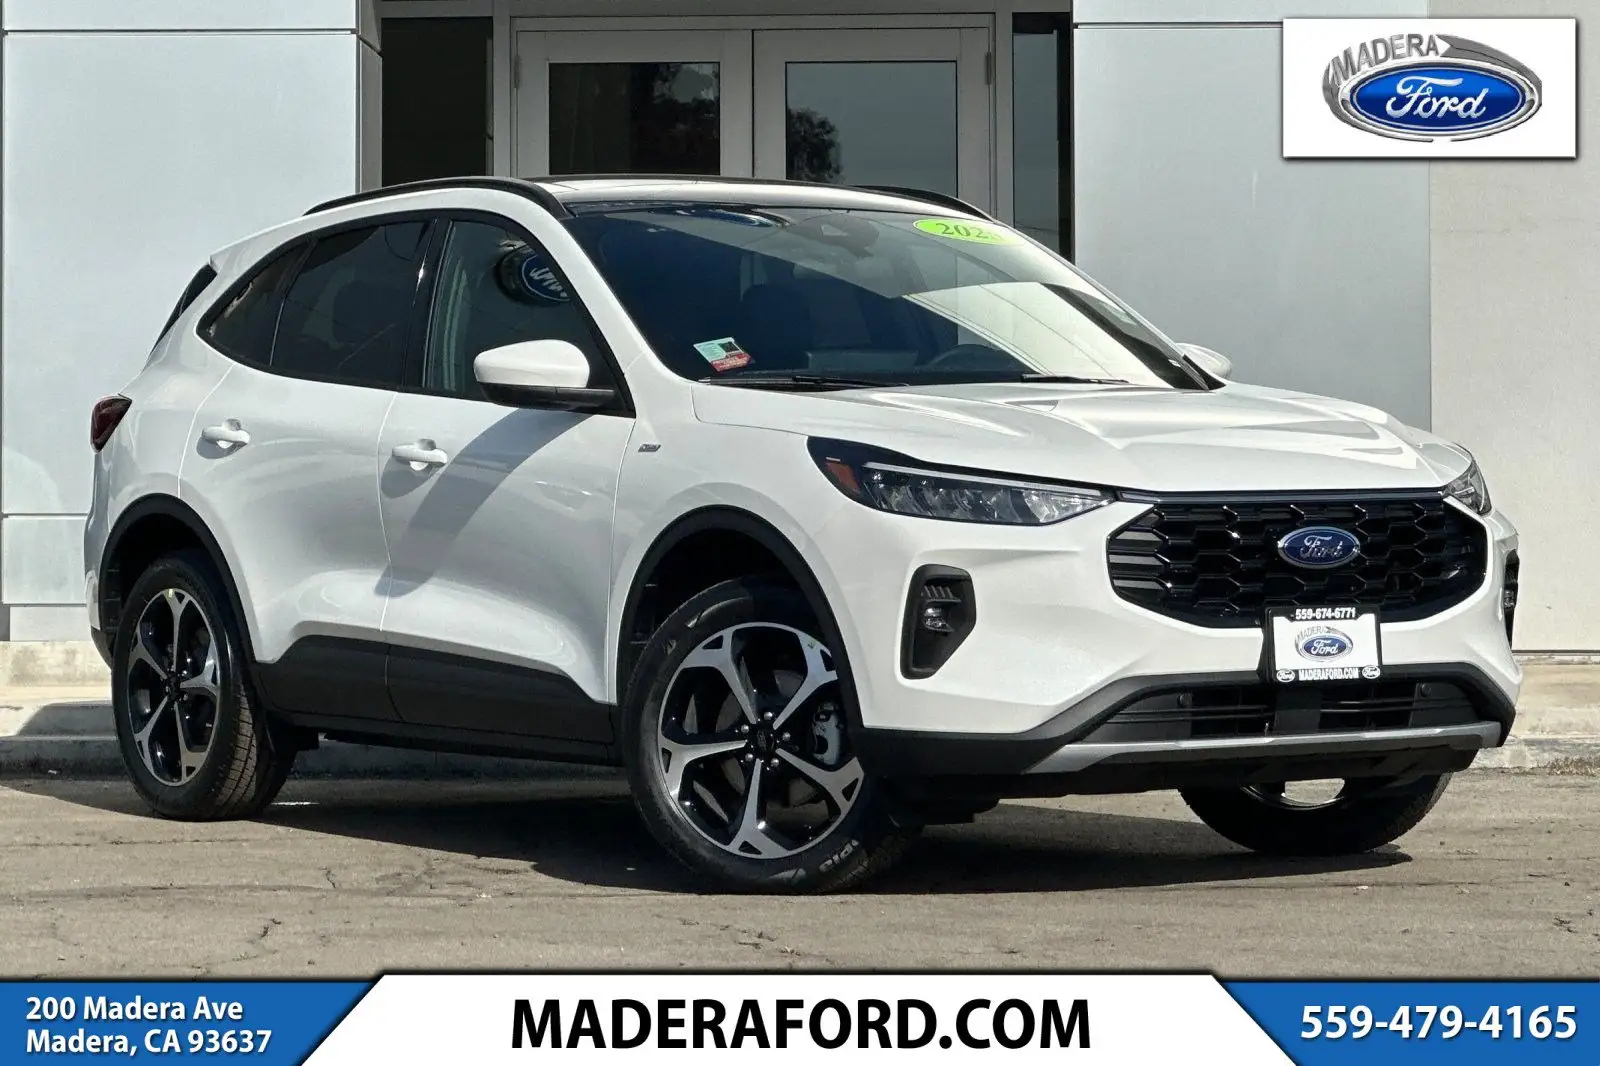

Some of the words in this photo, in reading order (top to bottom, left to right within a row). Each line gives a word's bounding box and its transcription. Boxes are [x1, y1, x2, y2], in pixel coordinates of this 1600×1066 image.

[935, 222, 1004, 242] 202
[1301, 535, 1344, 558] Ford
[1295, 607, 1356, 620] 559-674-6771
[1310, 638, 1339, 656] Ford
[1299, 667, 1360, 681] MADERAFORD.COM
